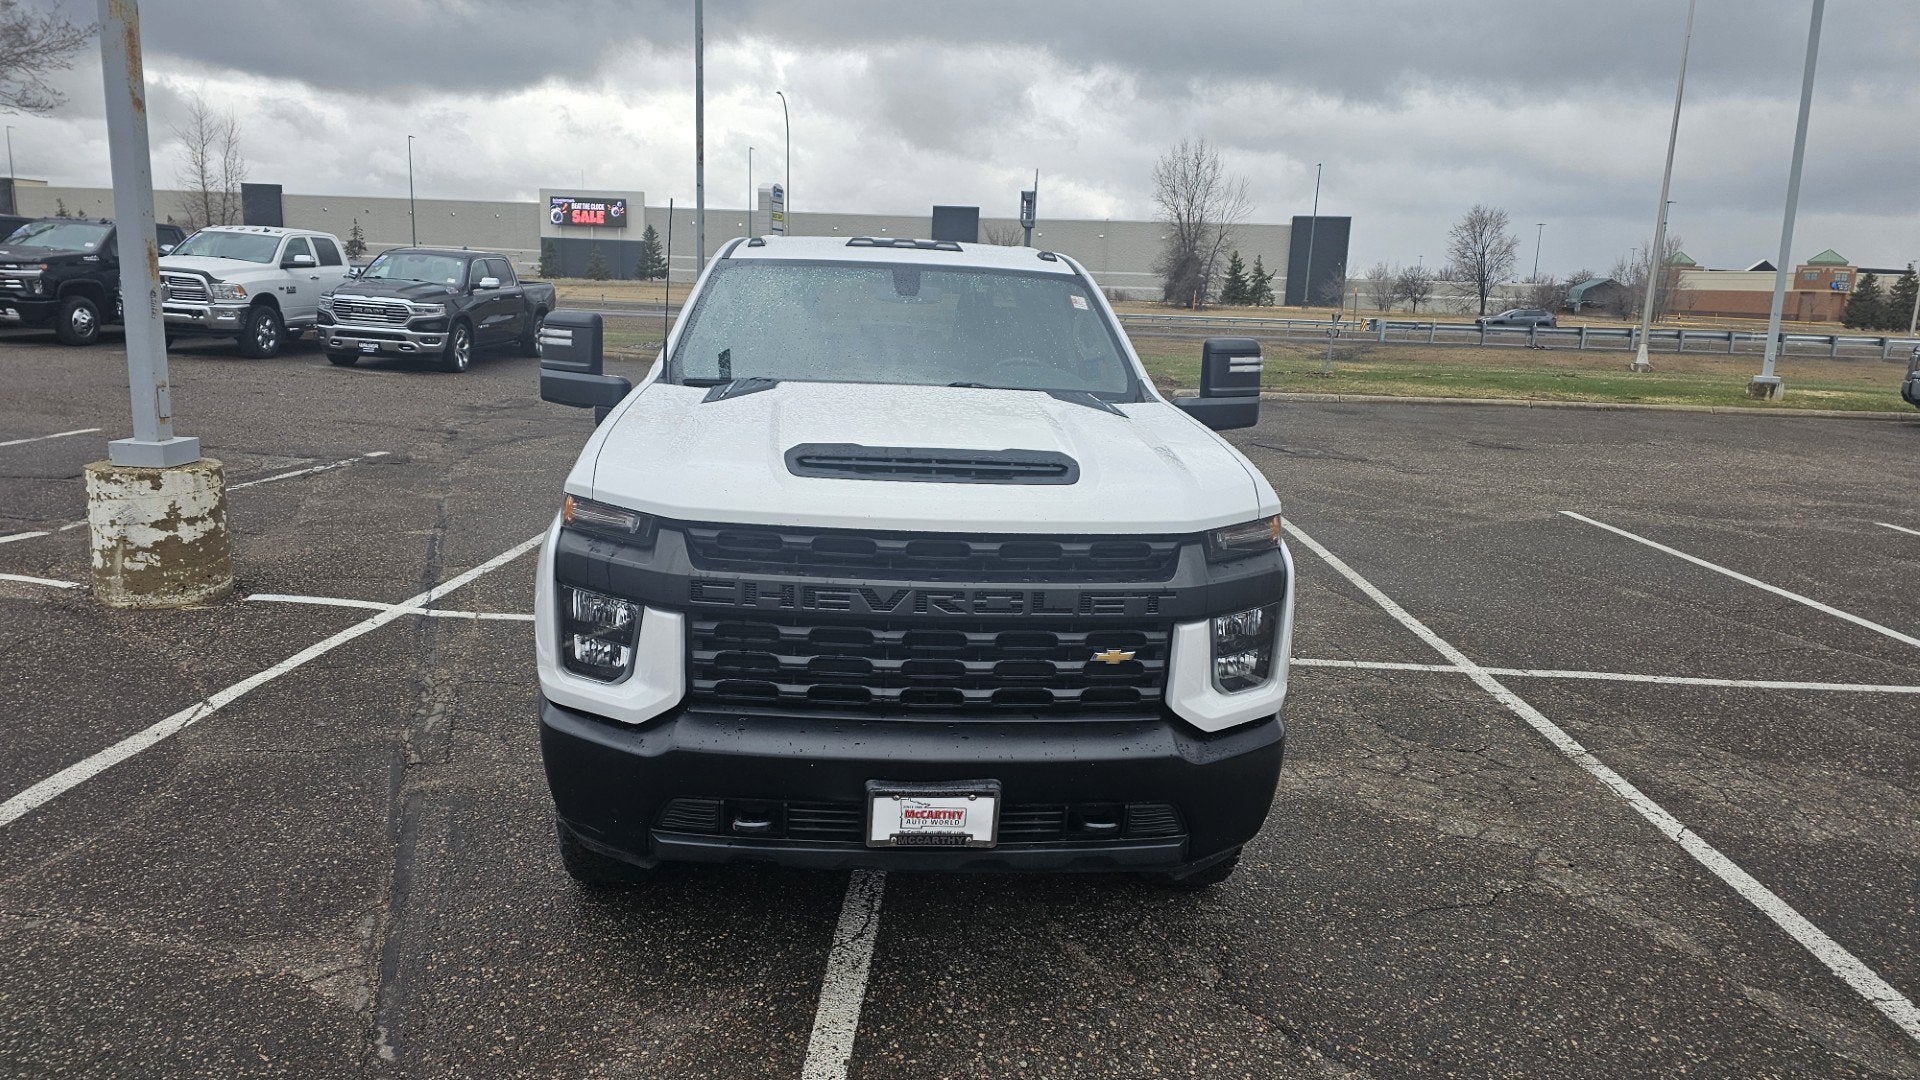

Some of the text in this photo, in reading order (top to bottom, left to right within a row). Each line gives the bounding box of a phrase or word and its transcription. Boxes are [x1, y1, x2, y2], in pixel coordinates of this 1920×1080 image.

[572, 211, 605, 223] SALE
[689, 578, 1178, 616] CHEVROLET
[904, 810, 964, 819] McCARTHY
[898, 836, 964, 845] MCCARTHY
